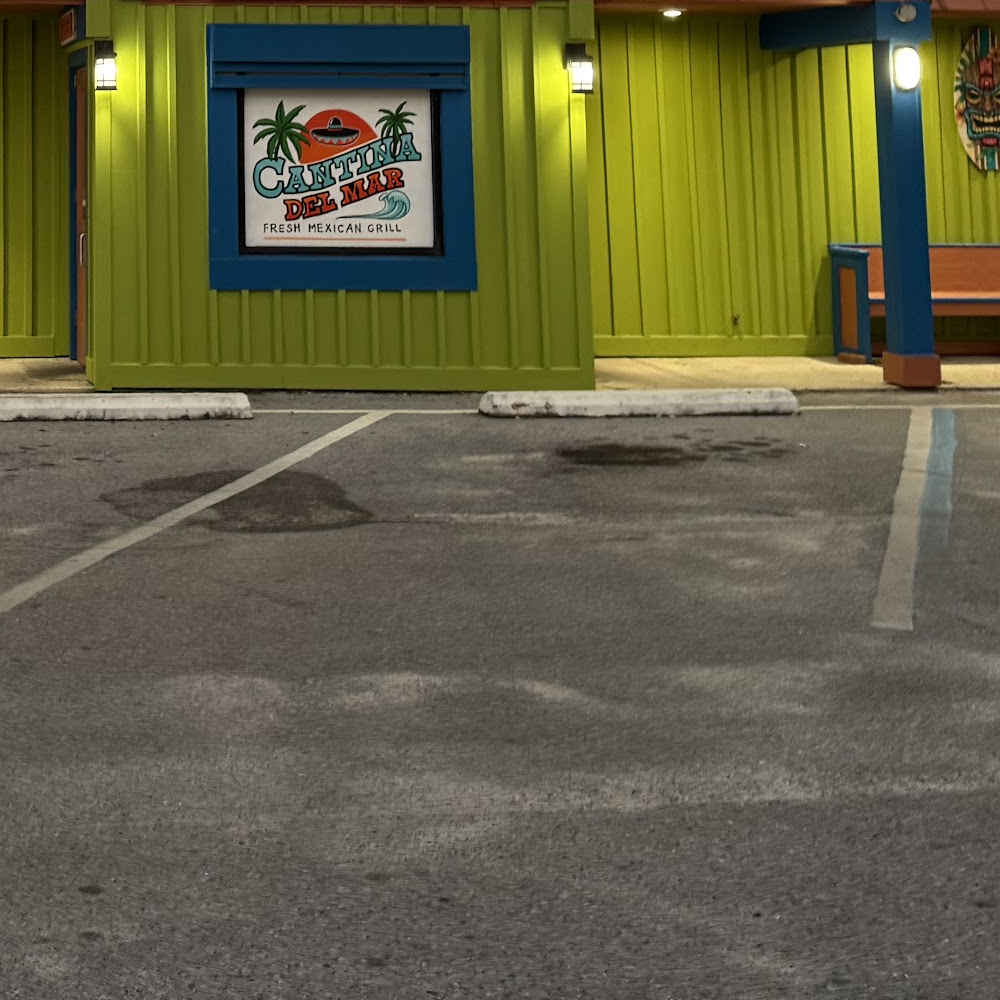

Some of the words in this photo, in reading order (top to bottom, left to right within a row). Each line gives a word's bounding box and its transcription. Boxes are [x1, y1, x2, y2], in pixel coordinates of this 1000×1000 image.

[252, 133, 422, 198] CANTINA
[283, 191, 339, 221] DEL
[340, 168, 405, 207] MAR
[263, 223, 301, 233] FRESH
[308, 223, 362, 234] MEXICAN
[367, 223, 402, 233] GRILL
